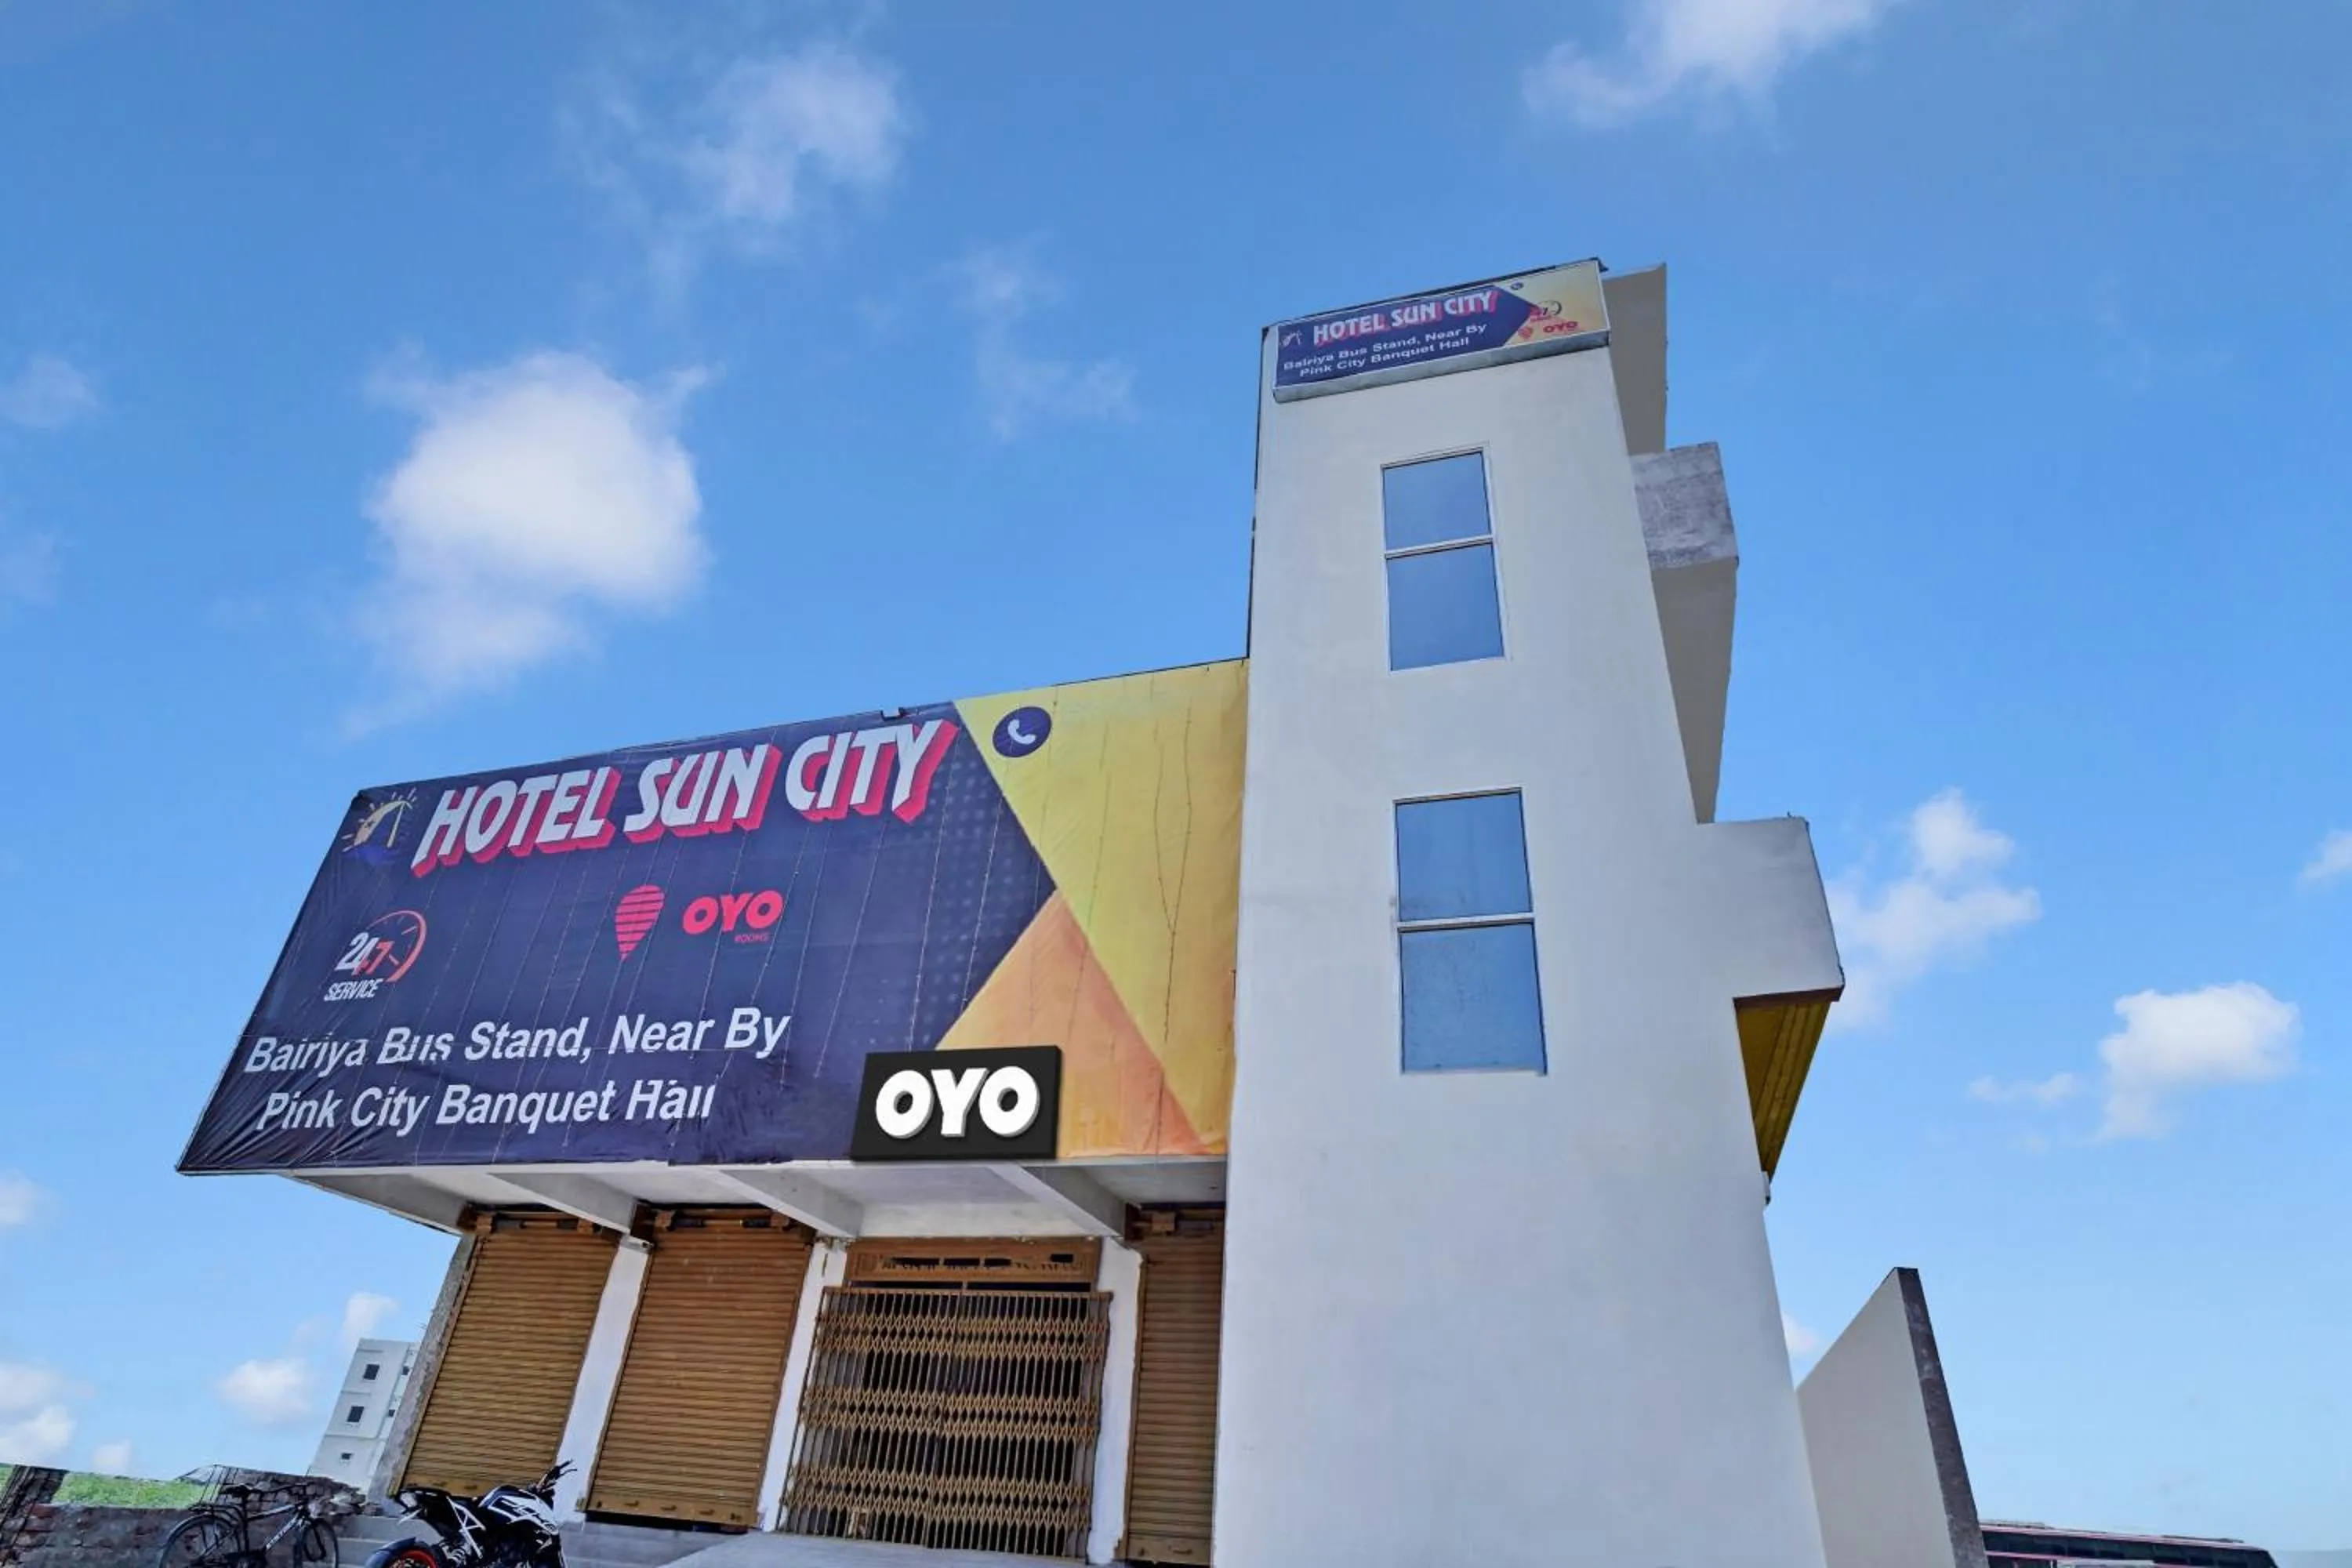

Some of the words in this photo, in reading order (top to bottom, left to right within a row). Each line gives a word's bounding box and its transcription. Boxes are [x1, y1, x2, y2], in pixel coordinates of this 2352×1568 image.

[1313, 314, 1389, 347] HOTEL
[1391, 302, 1441, 328] SUN
[1444, 290, 1497, 315] CITY
[1543, 321, 1578, 333] OYO
[1284, 354, 1334, 370] Bairiya
[1339, 347, 1367, 358] Bus
[1373, 336, 1421, 352] Stand,
[1425, 328, 1461, 342] Near
[1465, 324, 1487, 334] By
[1300, 365, 1333, 376] Pink
[1337, 358, 1366, 369] City
[1371, 344, 1435, 363] Banquet
[1439, 337, 1468, 350] Hall
[411, 766, 621, 877] HOTEL
[623, 743, 782, 843] SUN
[785, 719, 959, 823] CITY
[683, 890, 784, 935] OYO
[323, 978, 383, 1001] SERVICE
[244, 1033, 368, 1077] Bairiya
[376, 1026, 455, 1065] Bus
[464, 1017, 591, 1064] Stand,
[608, 1014, 715, 1054] Near
[724, 1007, 790, 1058] By
[256, 1090, 343, 1130] Pink
[350, 1085, 430, 1137] City
[435, 1080, 616, 1134] Banquet
[625, 1080, 716, 1120] Hall
[876, 1065, 1040, 1138] OYO
